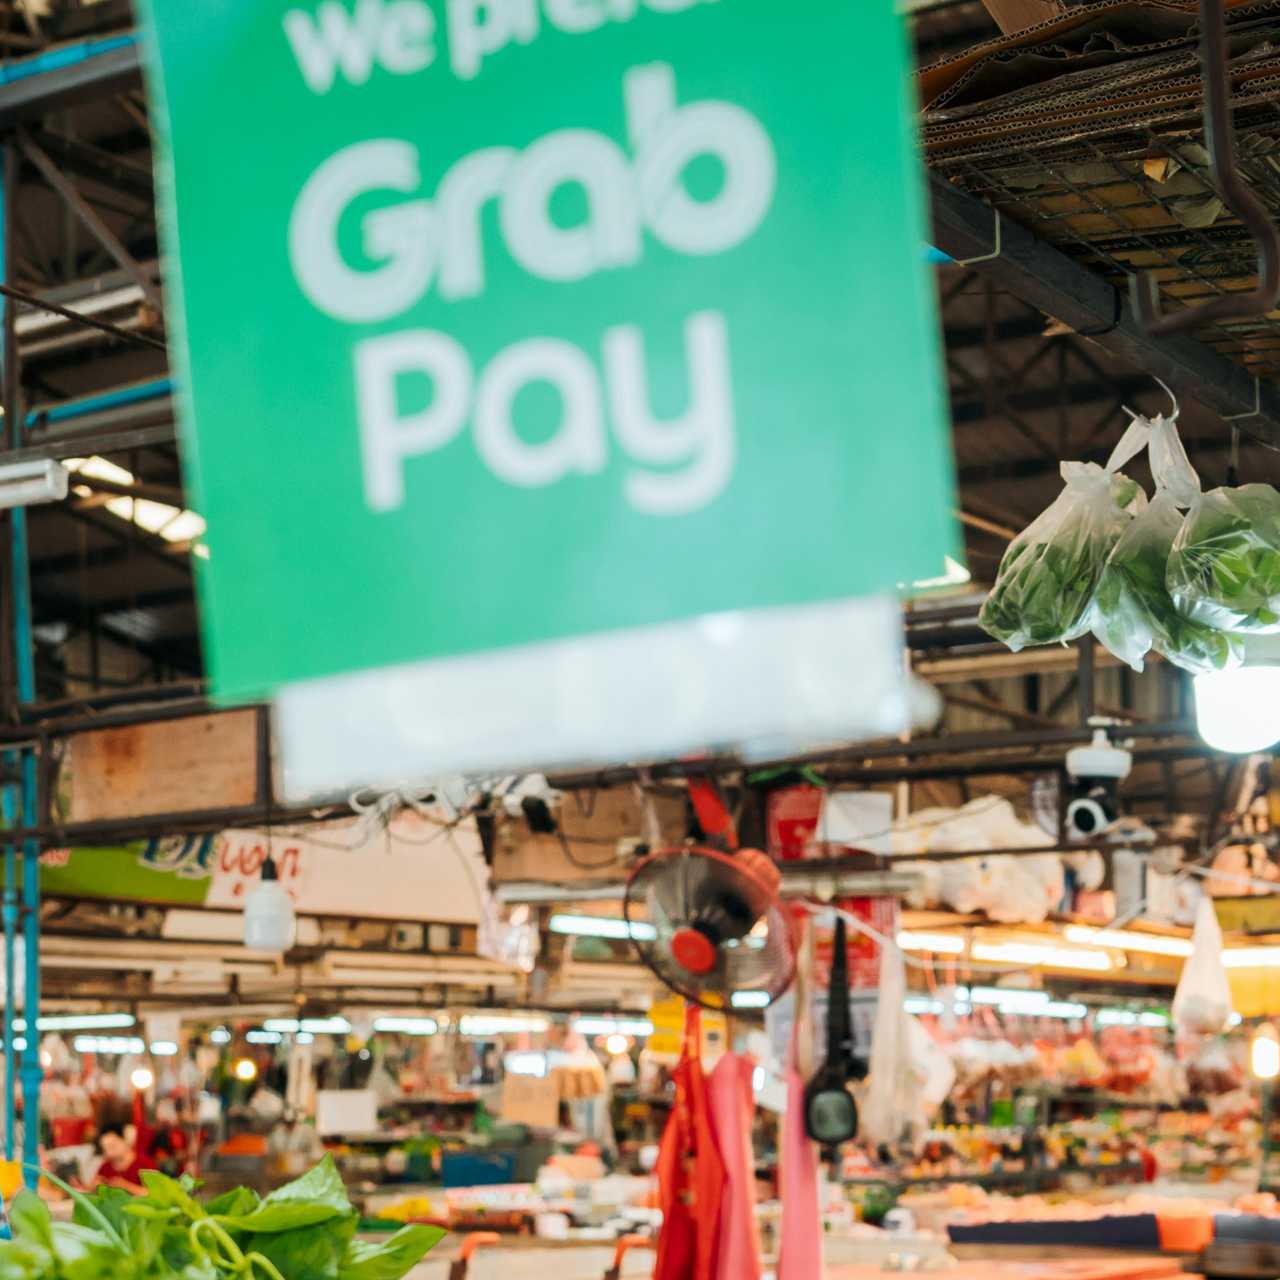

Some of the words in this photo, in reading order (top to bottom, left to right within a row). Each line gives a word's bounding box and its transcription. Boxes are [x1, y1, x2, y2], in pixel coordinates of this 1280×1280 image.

[283, 0, 437, 94] We
[288, 61, 776, 323] Grab
[353, 309, 736, 516] Pay
